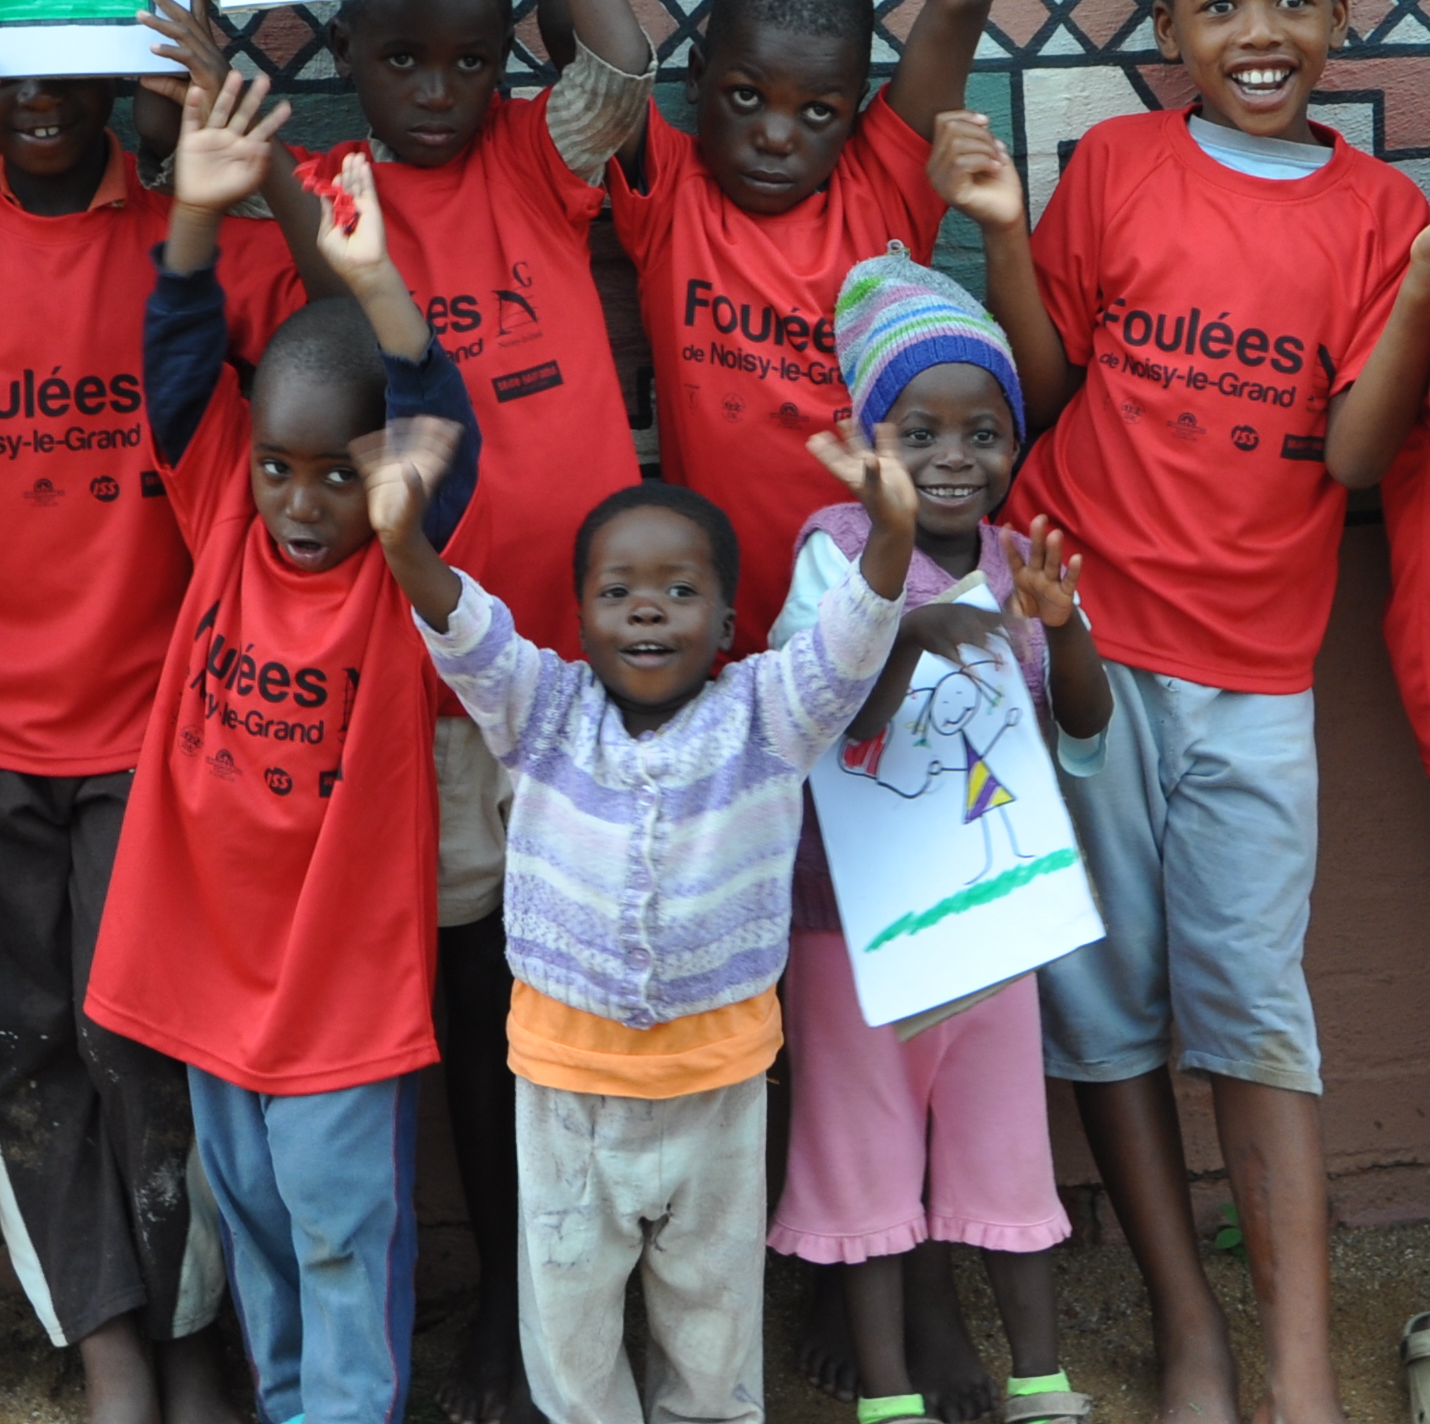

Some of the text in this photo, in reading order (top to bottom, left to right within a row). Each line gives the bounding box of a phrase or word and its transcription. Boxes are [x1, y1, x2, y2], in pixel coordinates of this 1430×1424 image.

[684, 278, 835, 354] Foulée
[683, 344, 705, 362] de
[1099, 352, 1297, 408] de Noisy-le-Grand
